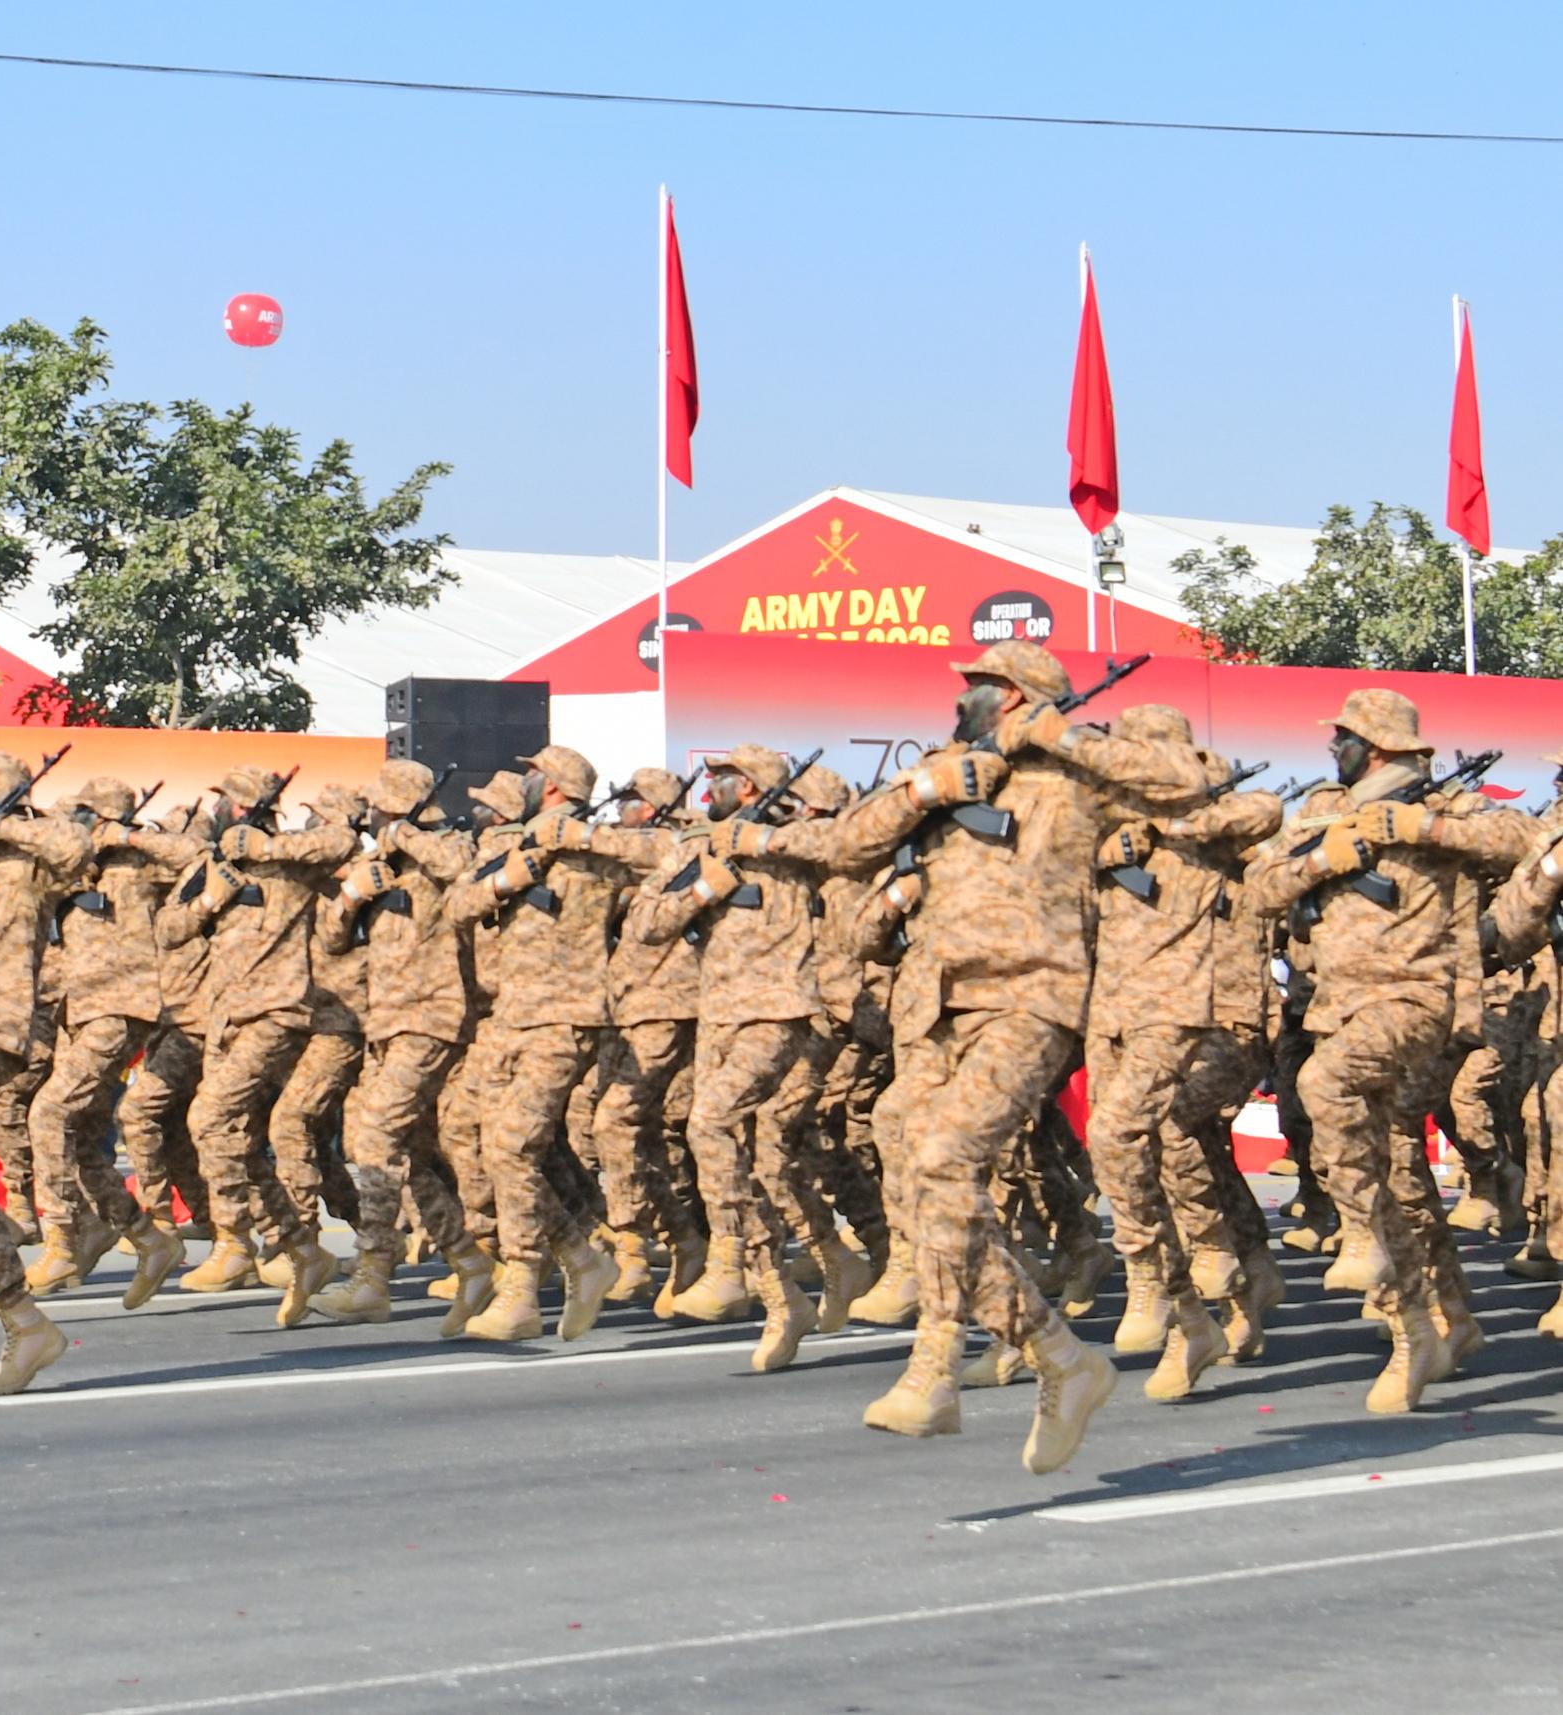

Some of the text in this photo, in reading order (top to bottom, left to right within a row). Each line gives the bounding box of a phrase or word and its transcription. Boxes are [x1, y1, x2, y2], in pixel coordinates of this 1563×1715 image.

[740, 585, 926, 633] ARMY DAY
[973, 617, 1051, 640] SINDOOR
